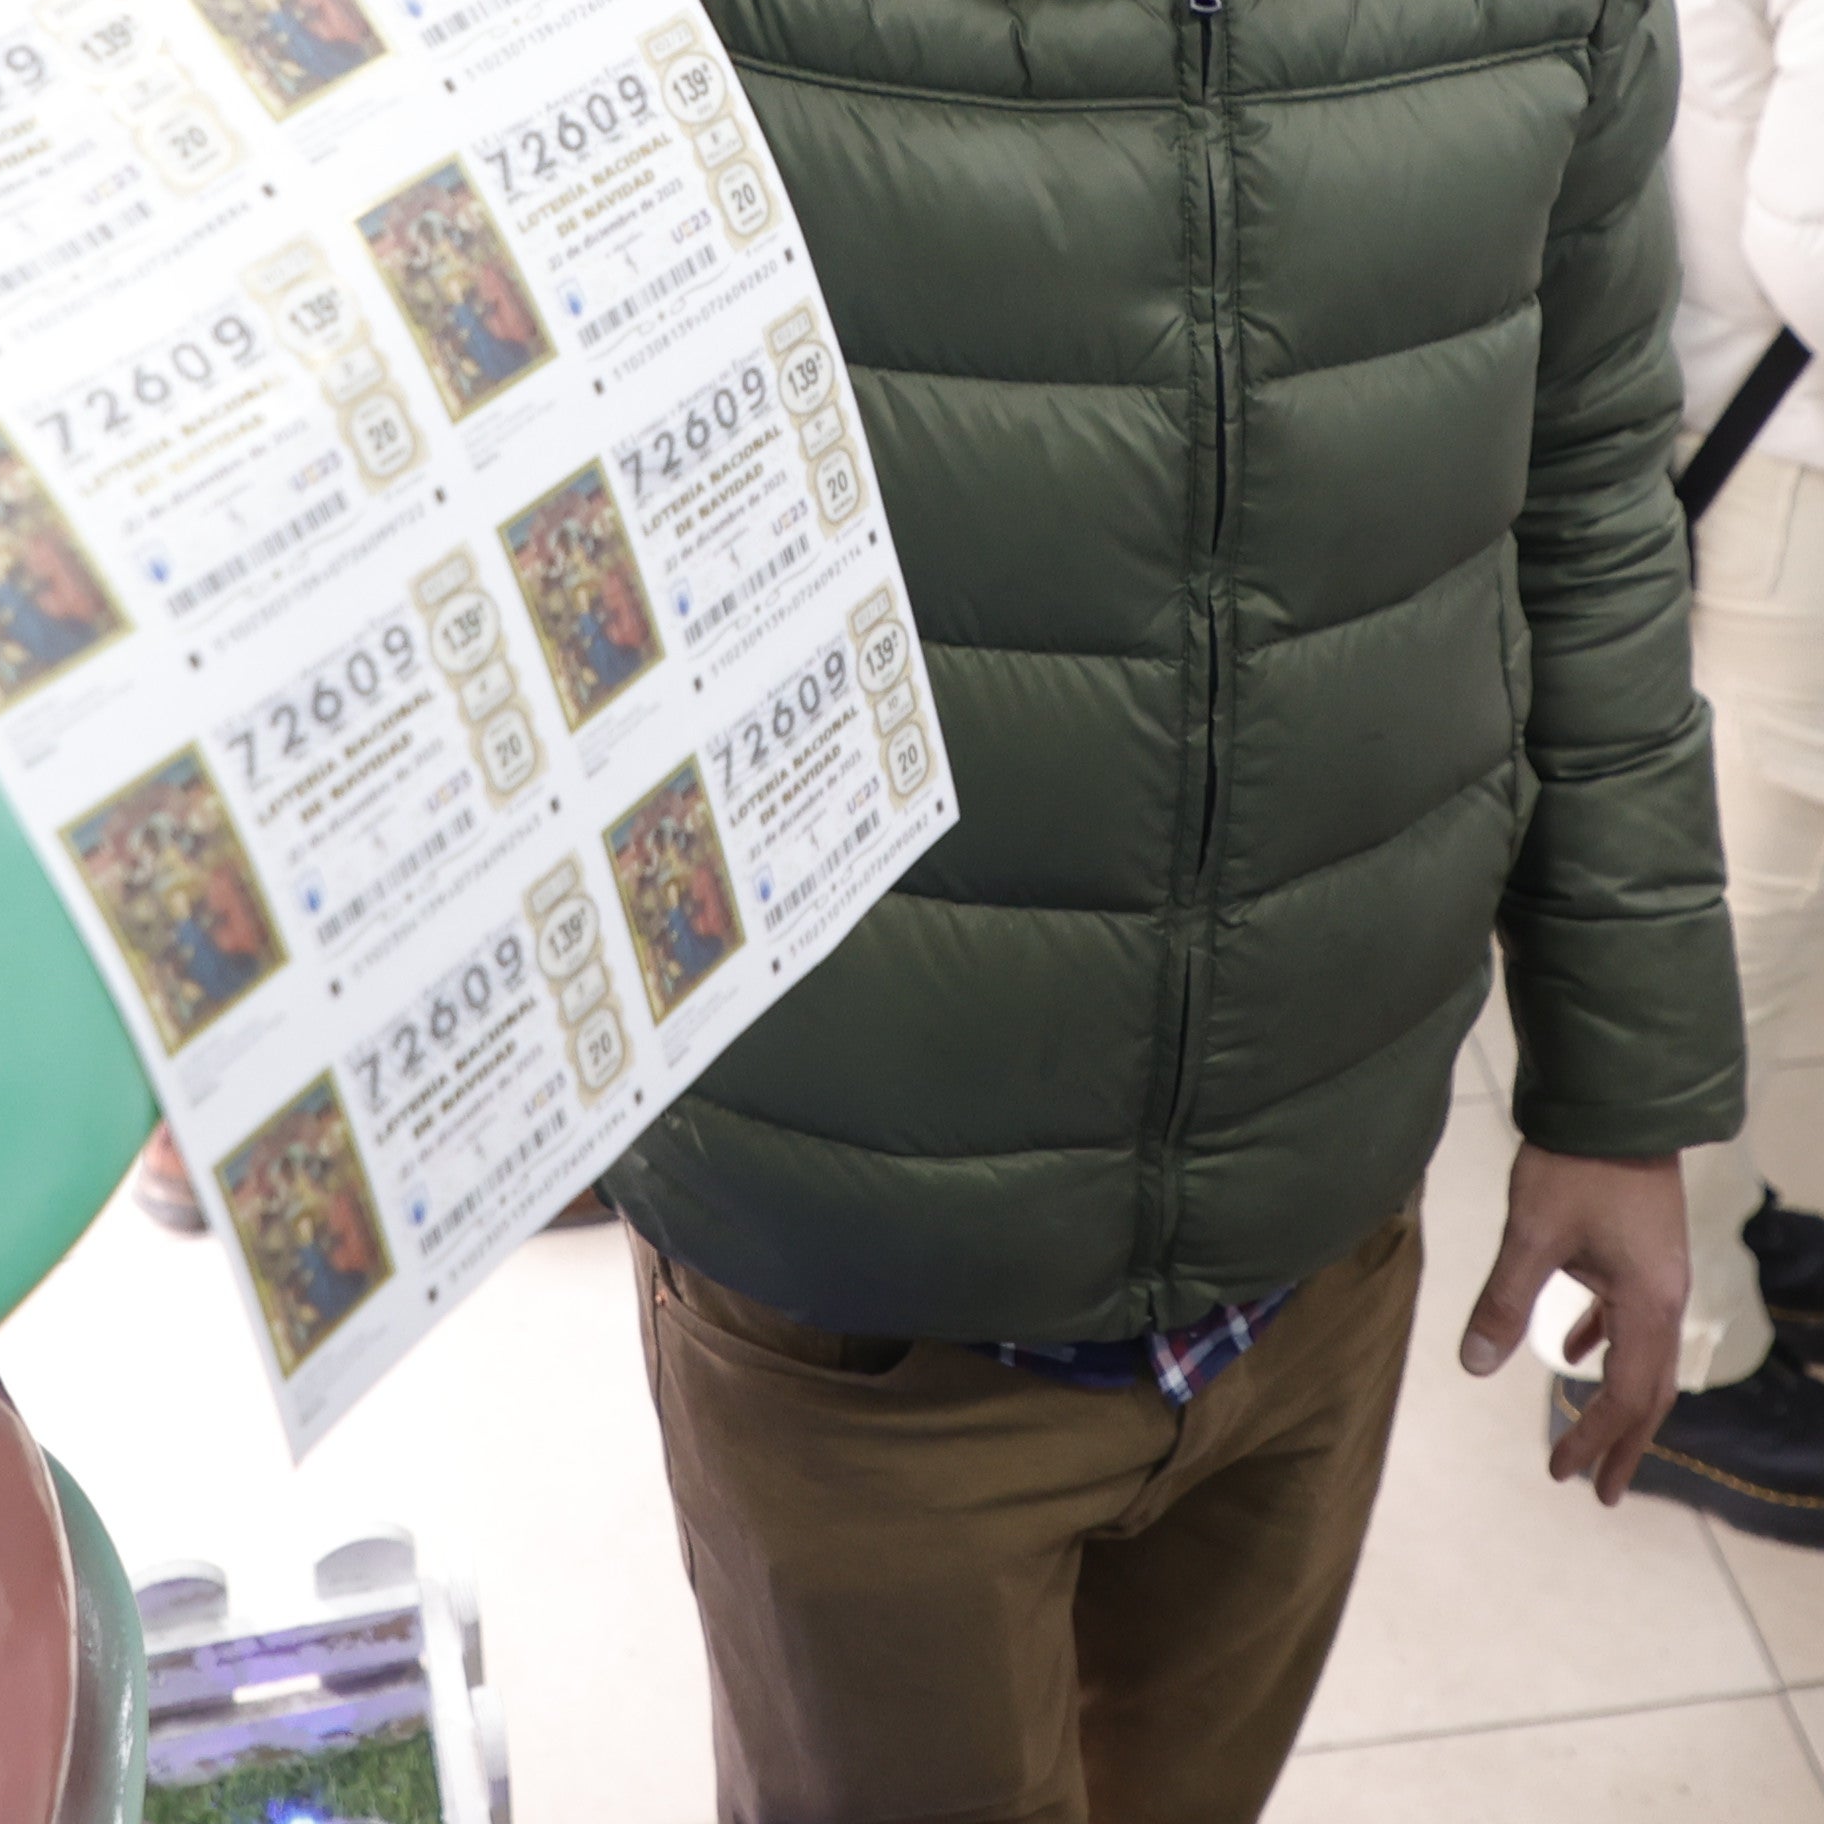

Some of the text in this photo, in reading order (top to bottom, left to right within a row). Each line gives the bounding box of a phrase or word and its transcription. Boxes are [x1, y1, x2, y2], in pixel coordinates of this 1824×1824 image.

[167, 125, 208, 159] 20
[484, 74, 648, 193] 72609
[516, 132, 672, 234] LOTERÍA NACIONAL
[581, 169, 654, 220] NAVIDAD
[730, 182, 756, 214] 20
[35, 313, 256, 456] 72609
[619, 366, 766, 495] 72609
[641, 424, 782, 537] LOTERÍA NACIONAL
[698, 462, 763, 518] NAVIDAD
[826, 469, 848, 501] 20
[226, 624, 414, 780] 72609
[713, 649, 846, 788] 72609
[330, 733, 412, 800] NAVIDAD
[495, 732, 522, 768] 20
[728, 705, 858, 827] LOTERÍA NACIONAL
[781, 744, 841, 804] NAVIDAD
[897, 742, 918, 775] 20
[353, 934, 523, 1105] 72609
[588, 1030, 612, 1066] 20
[440, 1041, 515, 1113] NAVIDAD
